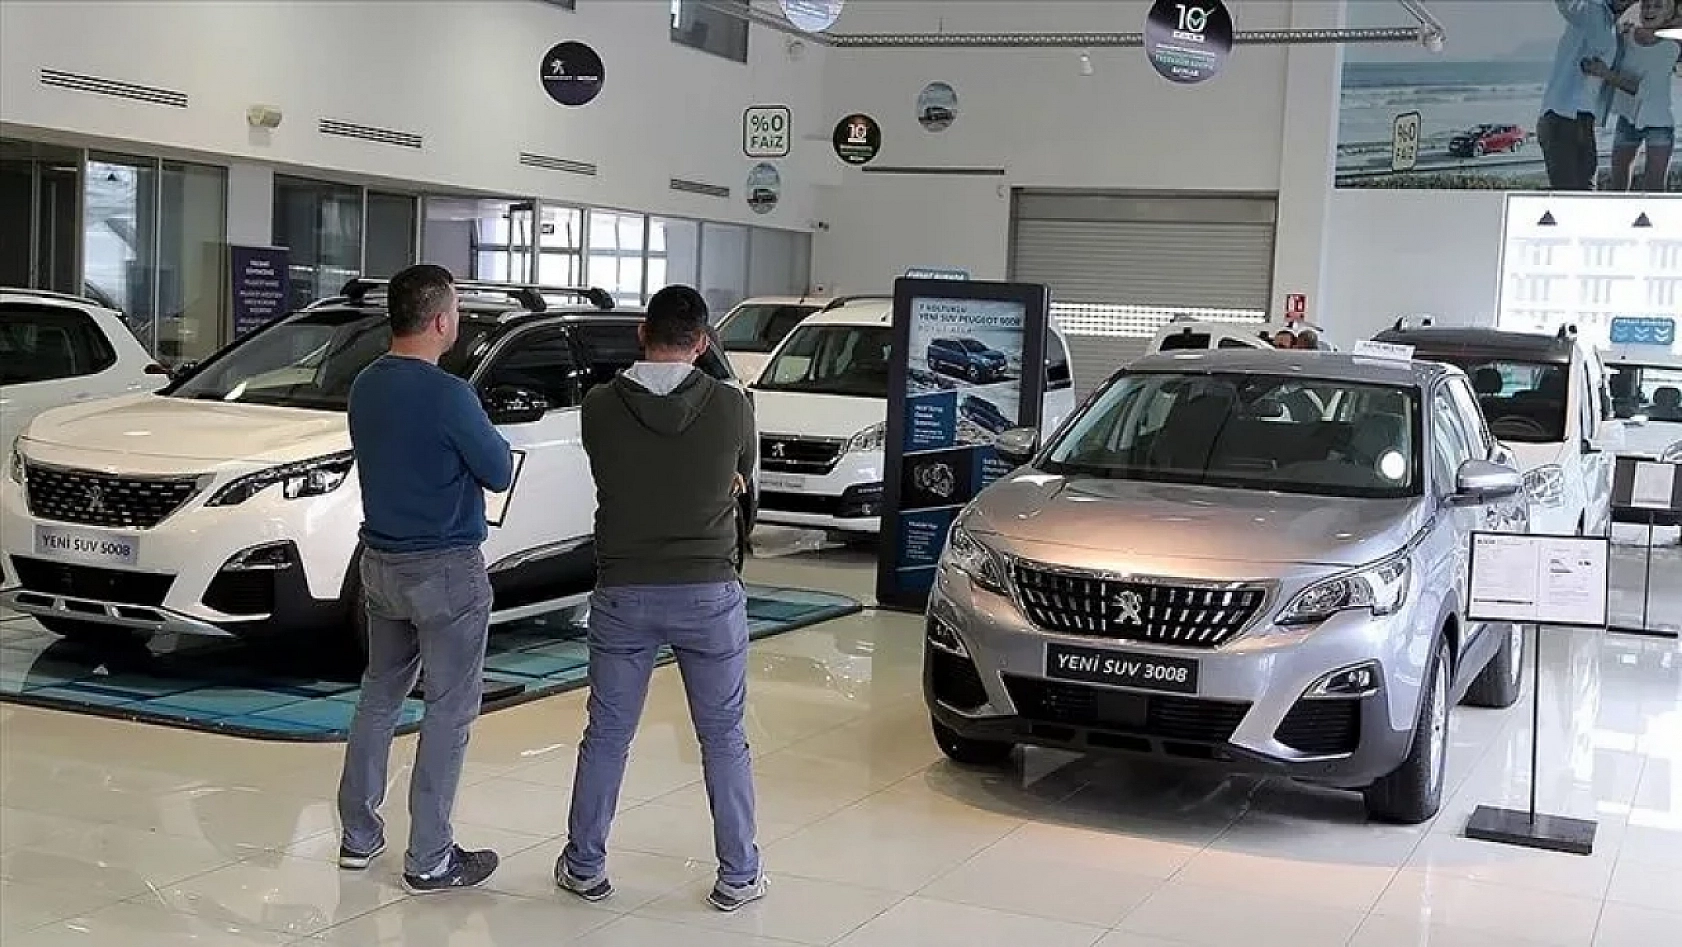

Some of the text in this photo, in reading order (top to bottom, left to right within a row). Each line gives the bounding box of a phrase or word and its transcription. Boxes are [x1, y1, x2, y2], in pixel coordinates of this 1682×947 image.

[1175, 3, 1207, 33] 10
[750, 114, 783, 132] %0
[74, 539, 99, 552] SUV
[1058, 653, 1189, 684] YENİ SUV 3008
